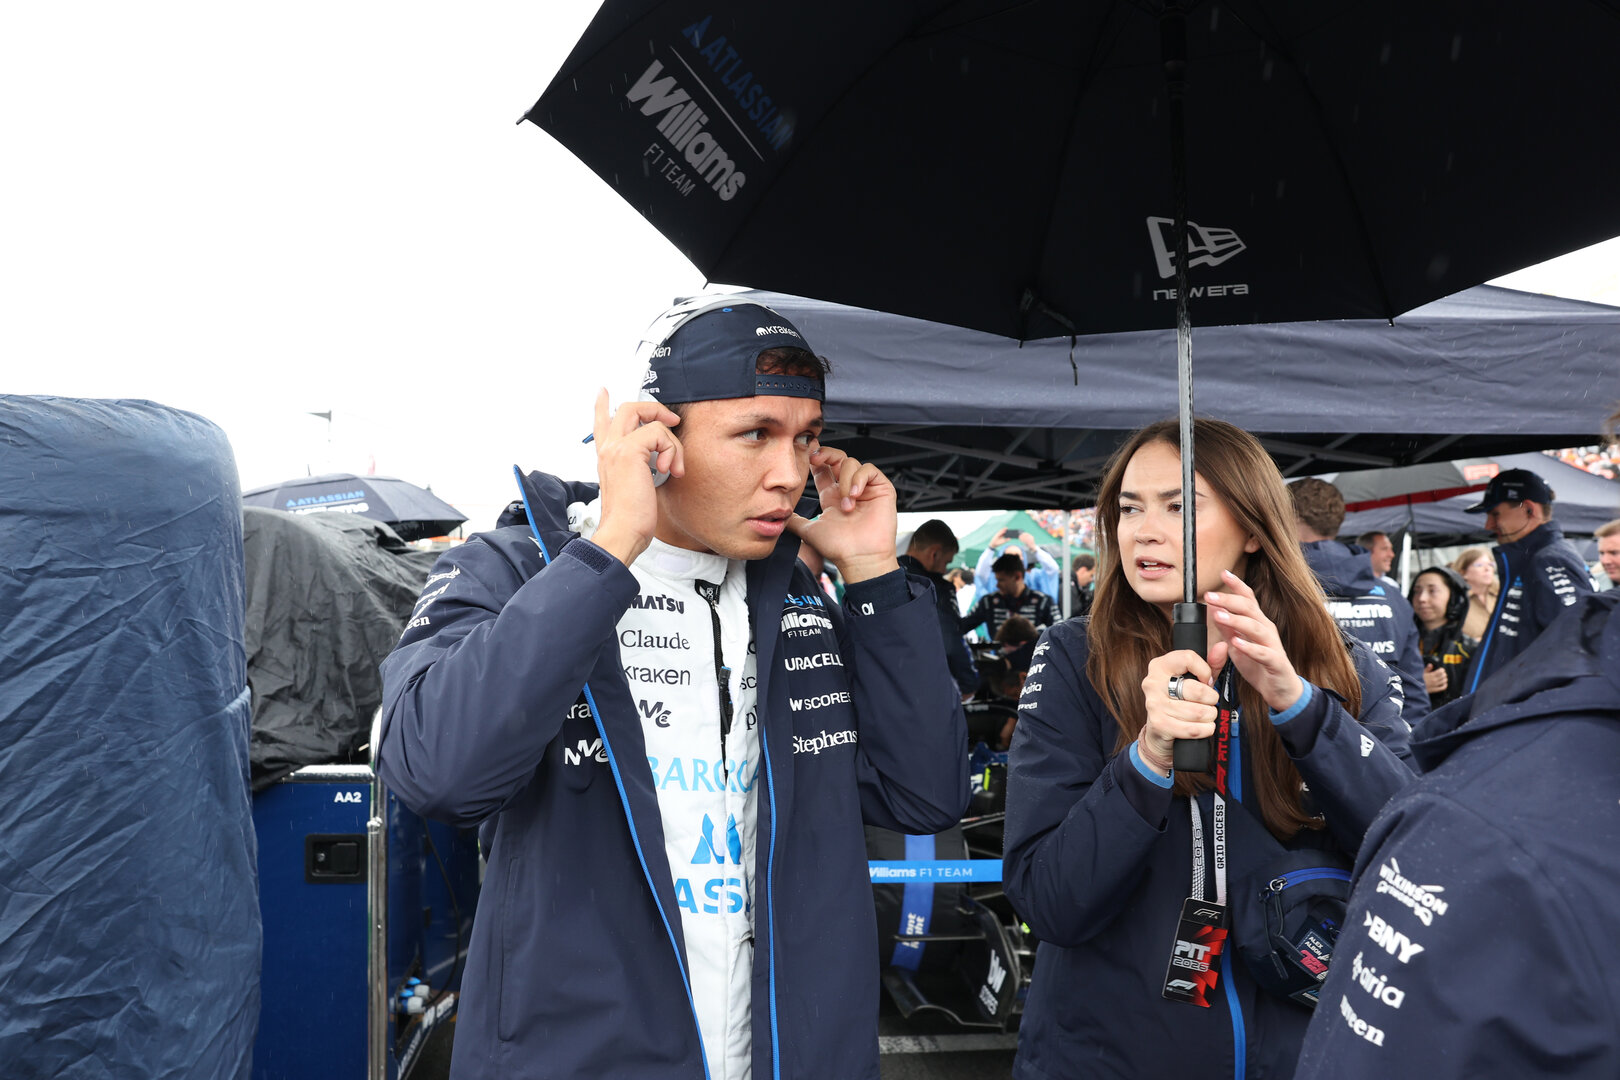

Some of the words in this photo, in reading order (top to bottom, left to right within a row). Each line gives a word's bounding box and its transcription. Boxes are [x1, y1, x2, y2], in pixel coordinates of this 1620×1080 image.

[700, 35, 794, 151] ATLASSIAN
[625, 58, 747, 201] Williams
[643, 142, 665, 165] F1
[660, 157, 697, 197] TEAM
[298, 489, 365, 506] ATLASSIAN
[620, 629, 691, 650] Claude
[799, 628, 821, 637] TEAM
[784, 652, 844, 671] URACELL
[623, 665, 691, 686] kraken
[792, 729, 858, 755] Stephens
[334, 792, 362, 803] AA2
[1216, 804, 1224, 842] ACCESS
[1216, 844, 1225, 870] GRID
[920, 868, 932, 877] F1
[937, 867, 973, 877] TEAM
[1368, 914, 1425, 964] BNY
[1174, 940, 1211, 961] PIT
